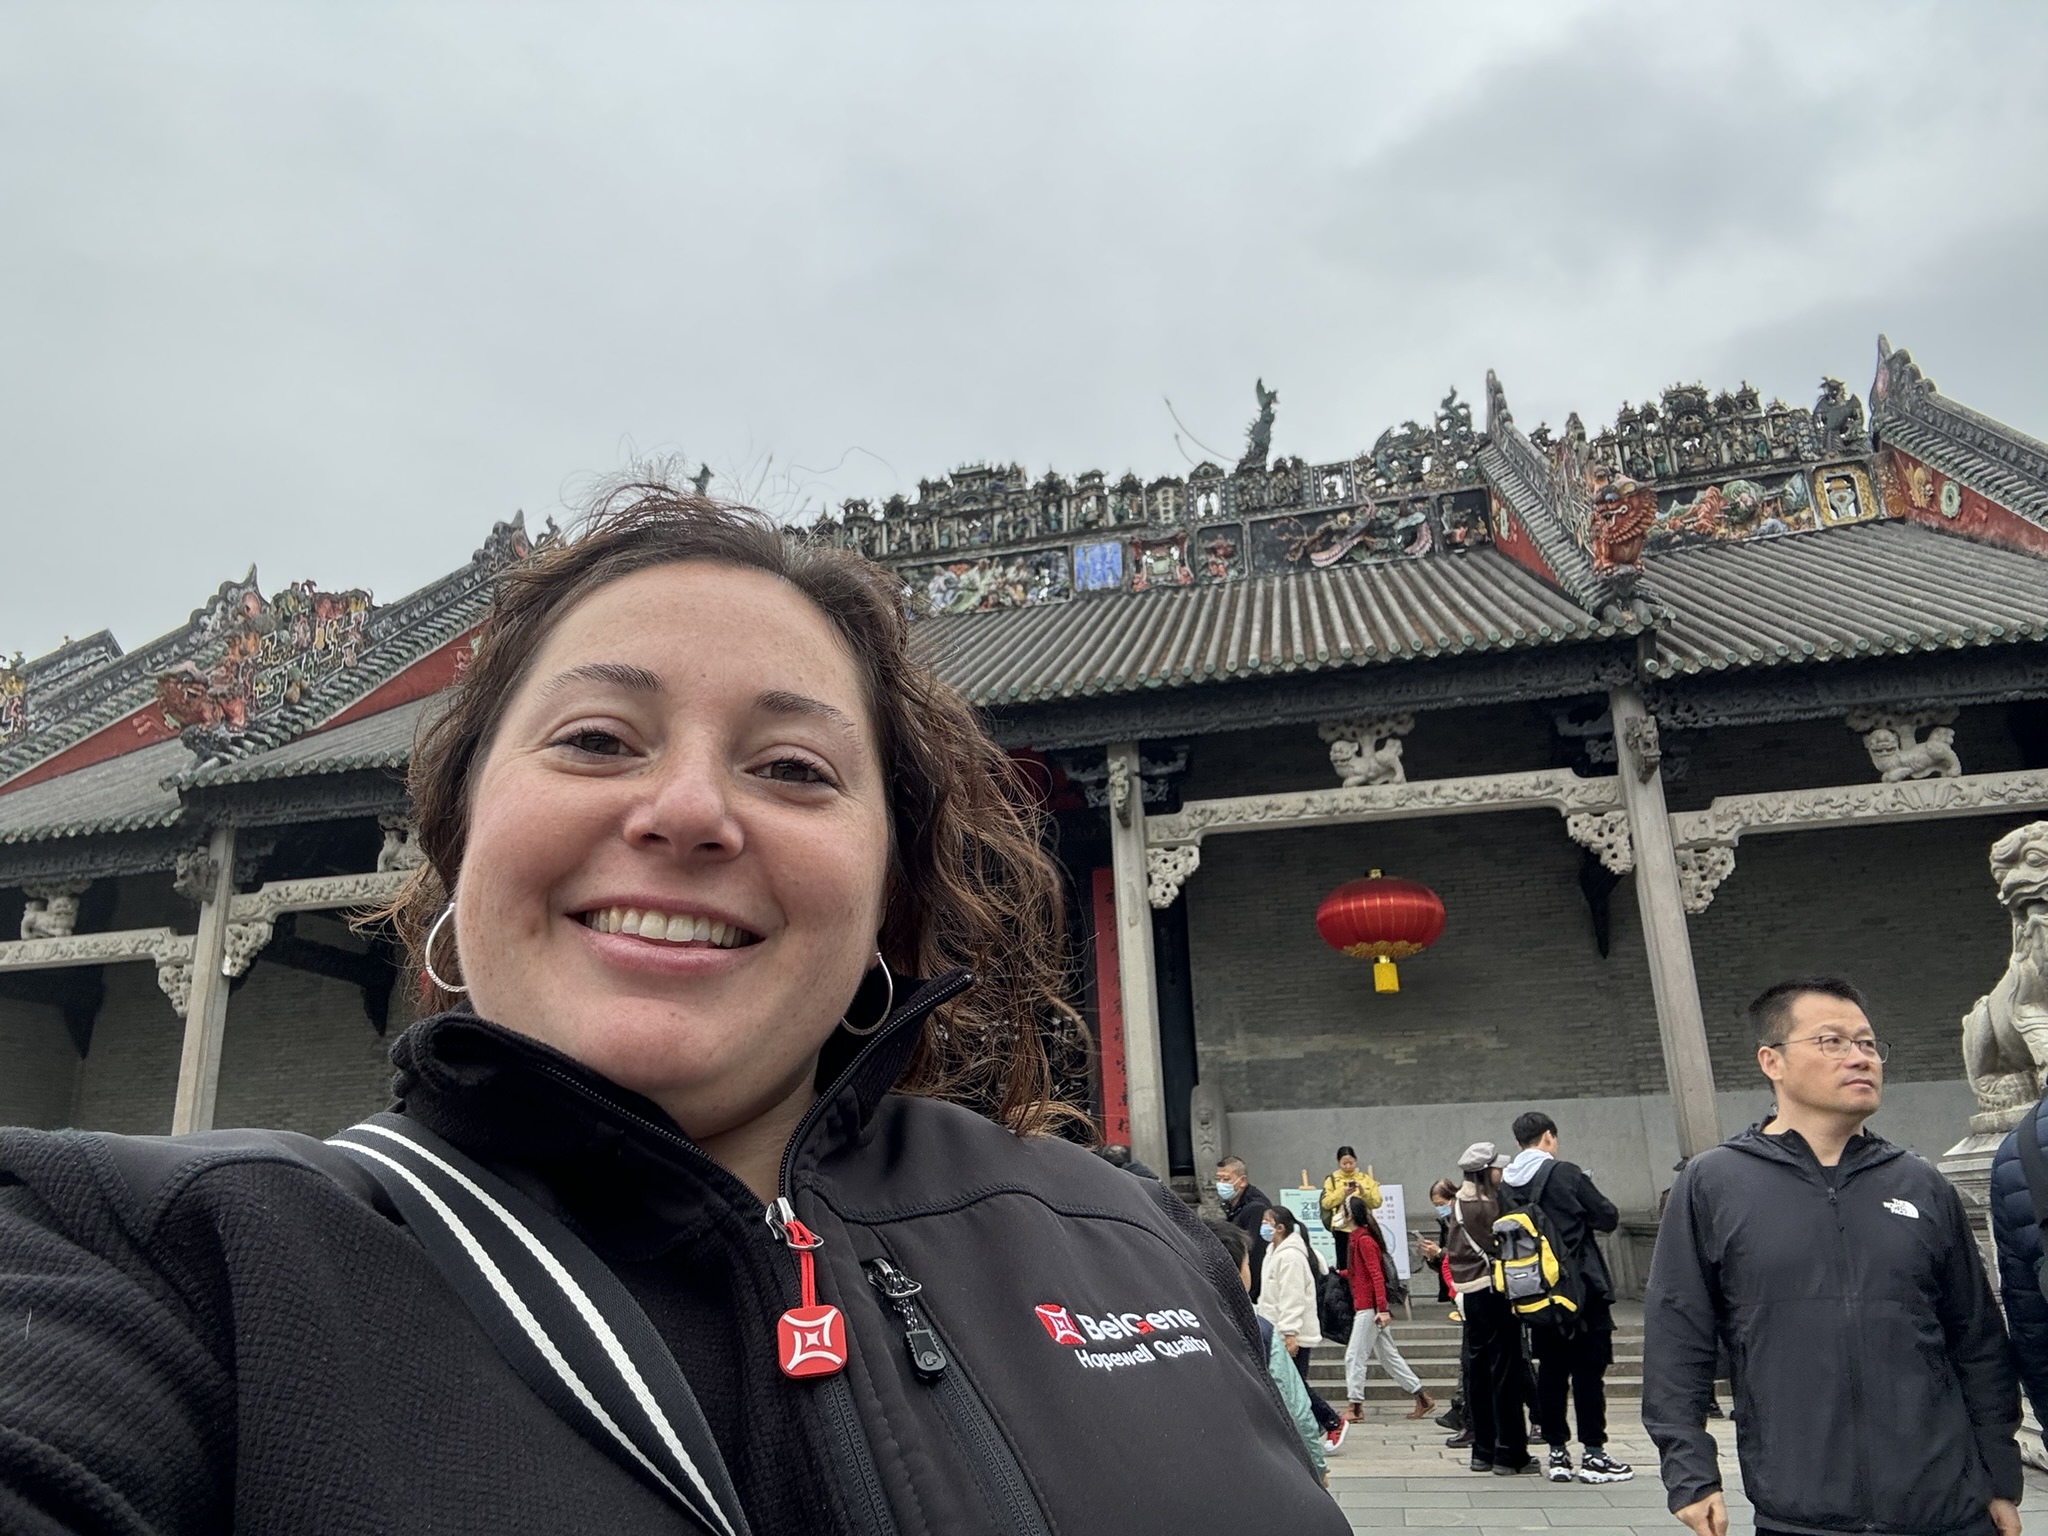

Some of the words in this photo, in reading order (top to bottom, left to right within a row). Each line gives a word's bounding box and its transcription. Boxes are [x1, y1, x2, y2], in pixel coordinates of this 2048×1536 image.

[1075, 1308, 1201, 1341] BeiGene
[1074, 1343, 1157, 1372] Hopewell
[1153, 1335, 1213, 1358] Quality
